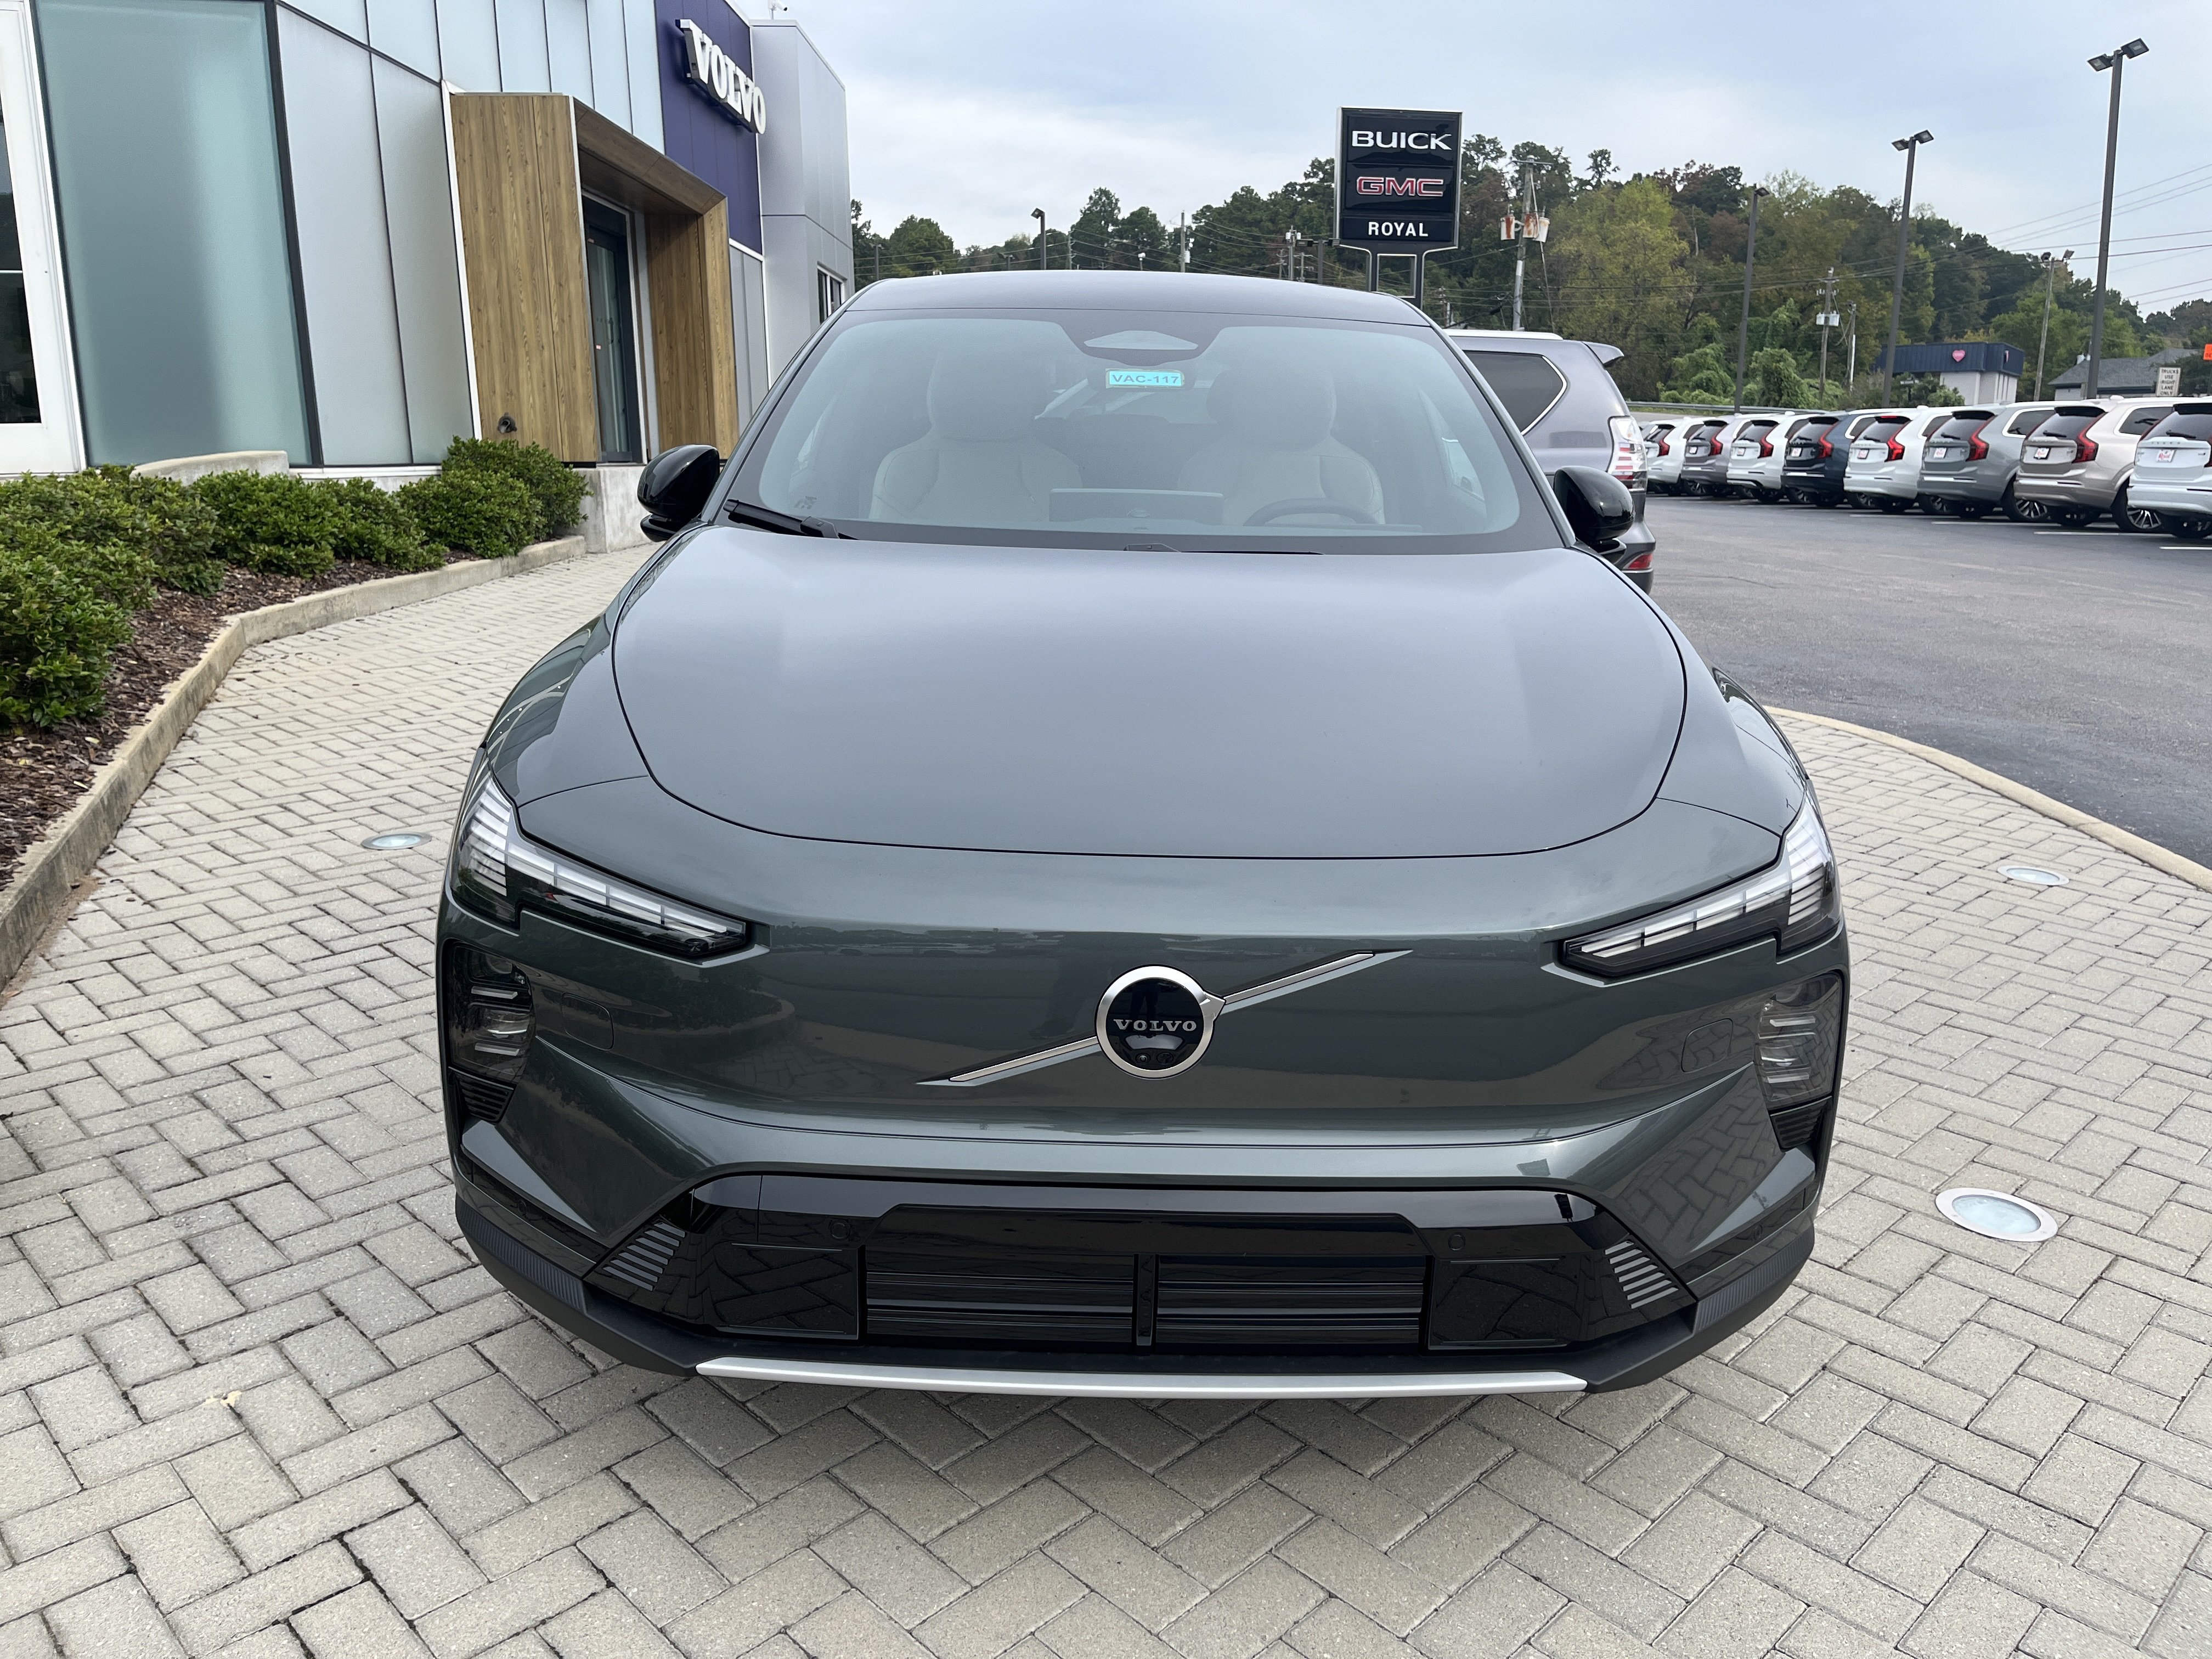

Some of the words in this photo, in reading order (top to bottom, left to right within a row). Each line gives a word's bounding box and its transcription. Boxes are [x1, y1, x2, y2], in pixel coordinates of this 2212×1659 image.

[679, 19, 766, 134] VOLVO
[1352, 131, 1452, 150] BUICK
[1356, 176, 1444, 197] GMC
[1368, 221, 1429, 237] ROYAL
[1111, 374, 1180, 384] VAC-117
[1113, 1018, 1197, 1032] VOLVO
